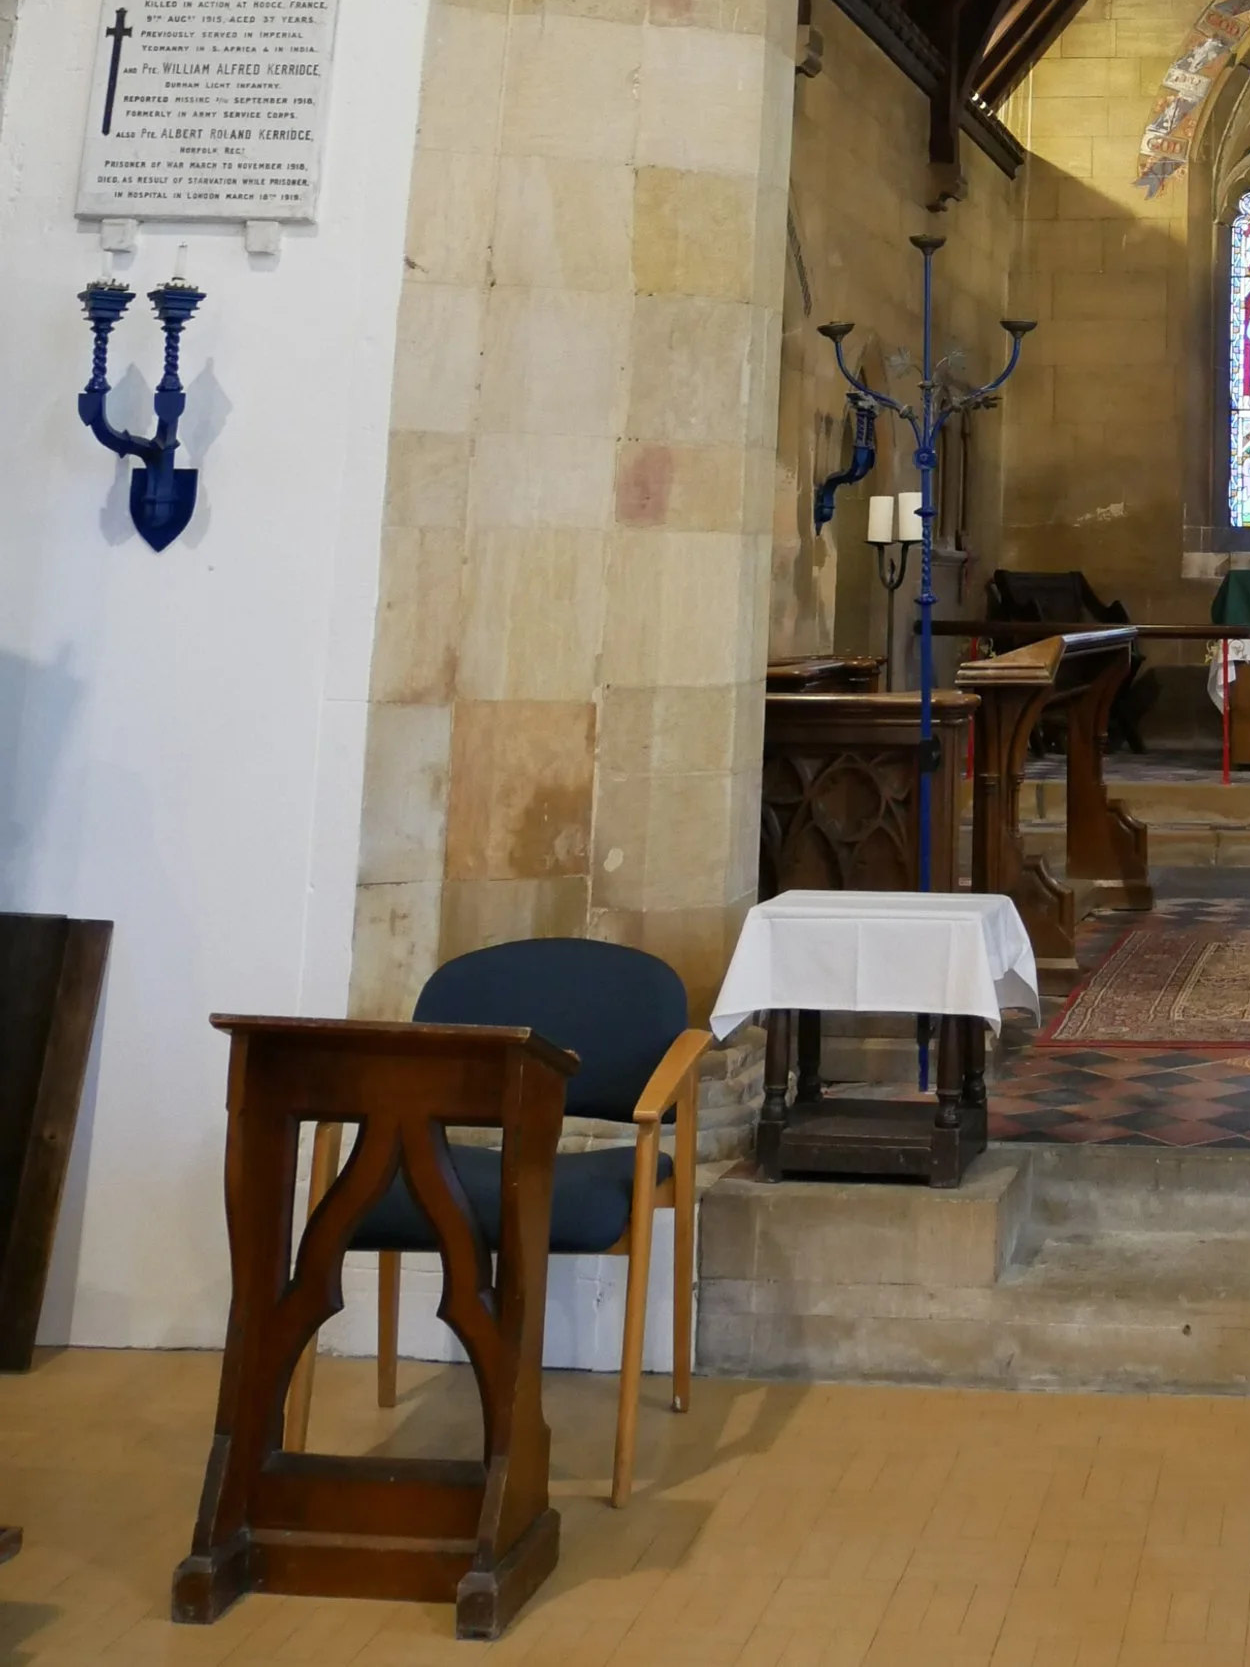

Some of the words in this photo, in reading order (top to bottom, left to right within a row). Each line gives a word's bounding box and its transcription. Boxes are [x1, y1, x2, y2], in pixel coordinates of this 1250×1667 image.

[163, 62, 210, 75] WILLIAM
[216, 63, 260, 75] ALFRED
[161, 129, 203, 139] ALBERT
[210, 129, 251, 140] ROLAND
[237, 162, 281, 170] NOVEMBER
[137, 176, 169, 184] RESULT
[188, 177, 237, 185] STARVATION
